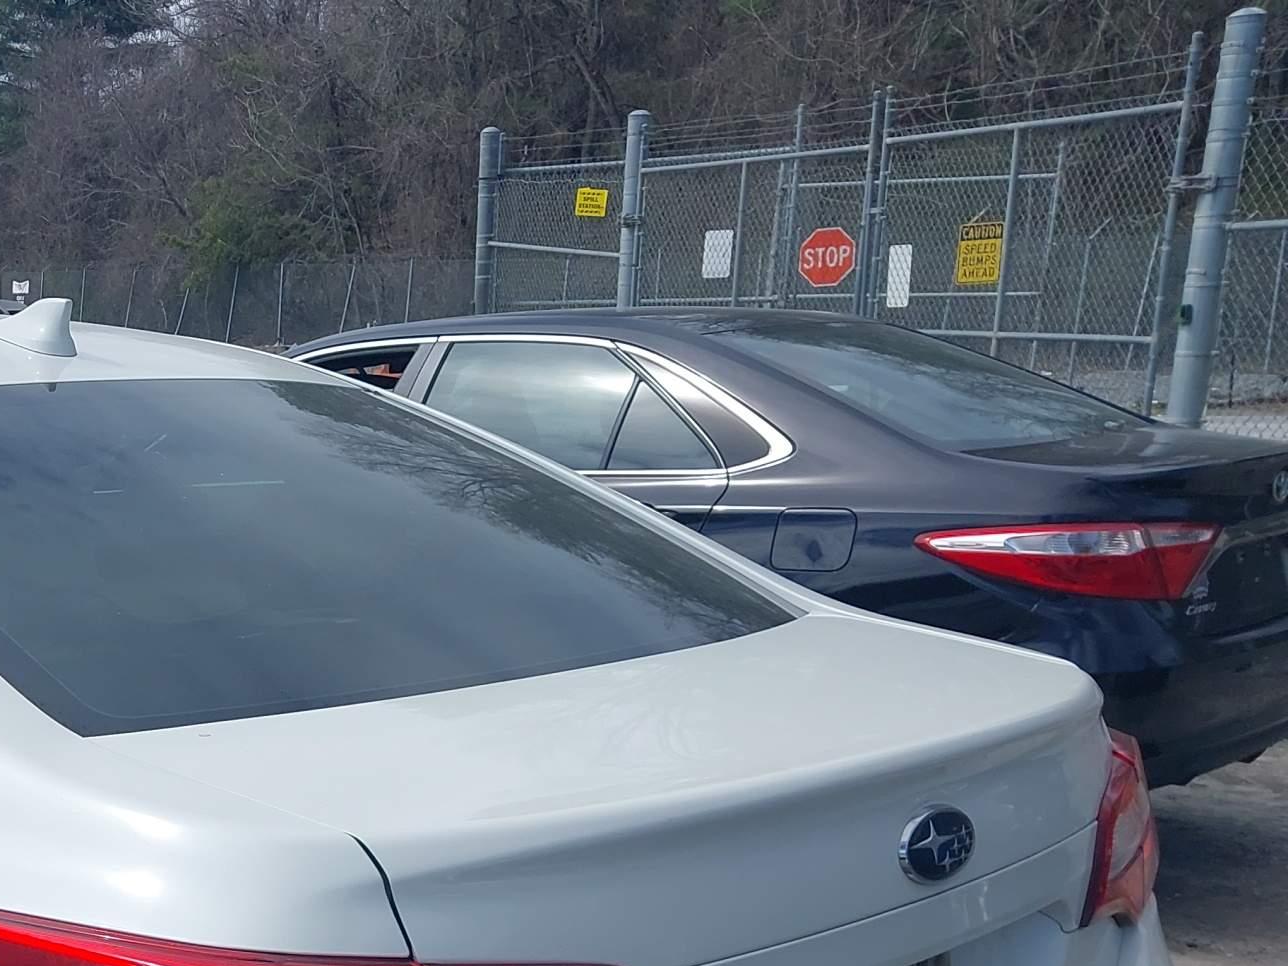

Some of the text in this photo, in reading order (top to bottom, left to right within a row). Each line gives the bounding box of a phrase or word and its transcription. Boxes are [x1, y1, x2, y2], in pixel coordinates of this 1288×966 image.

[962, 225, 1002, 240] CAUTION
[962, 243, 997, 256] SPEED
[803, 245, 850, 270] STOP
[962, 255, 997, 267] BUMPS
[961, 267, 995, 279] AHEAD
